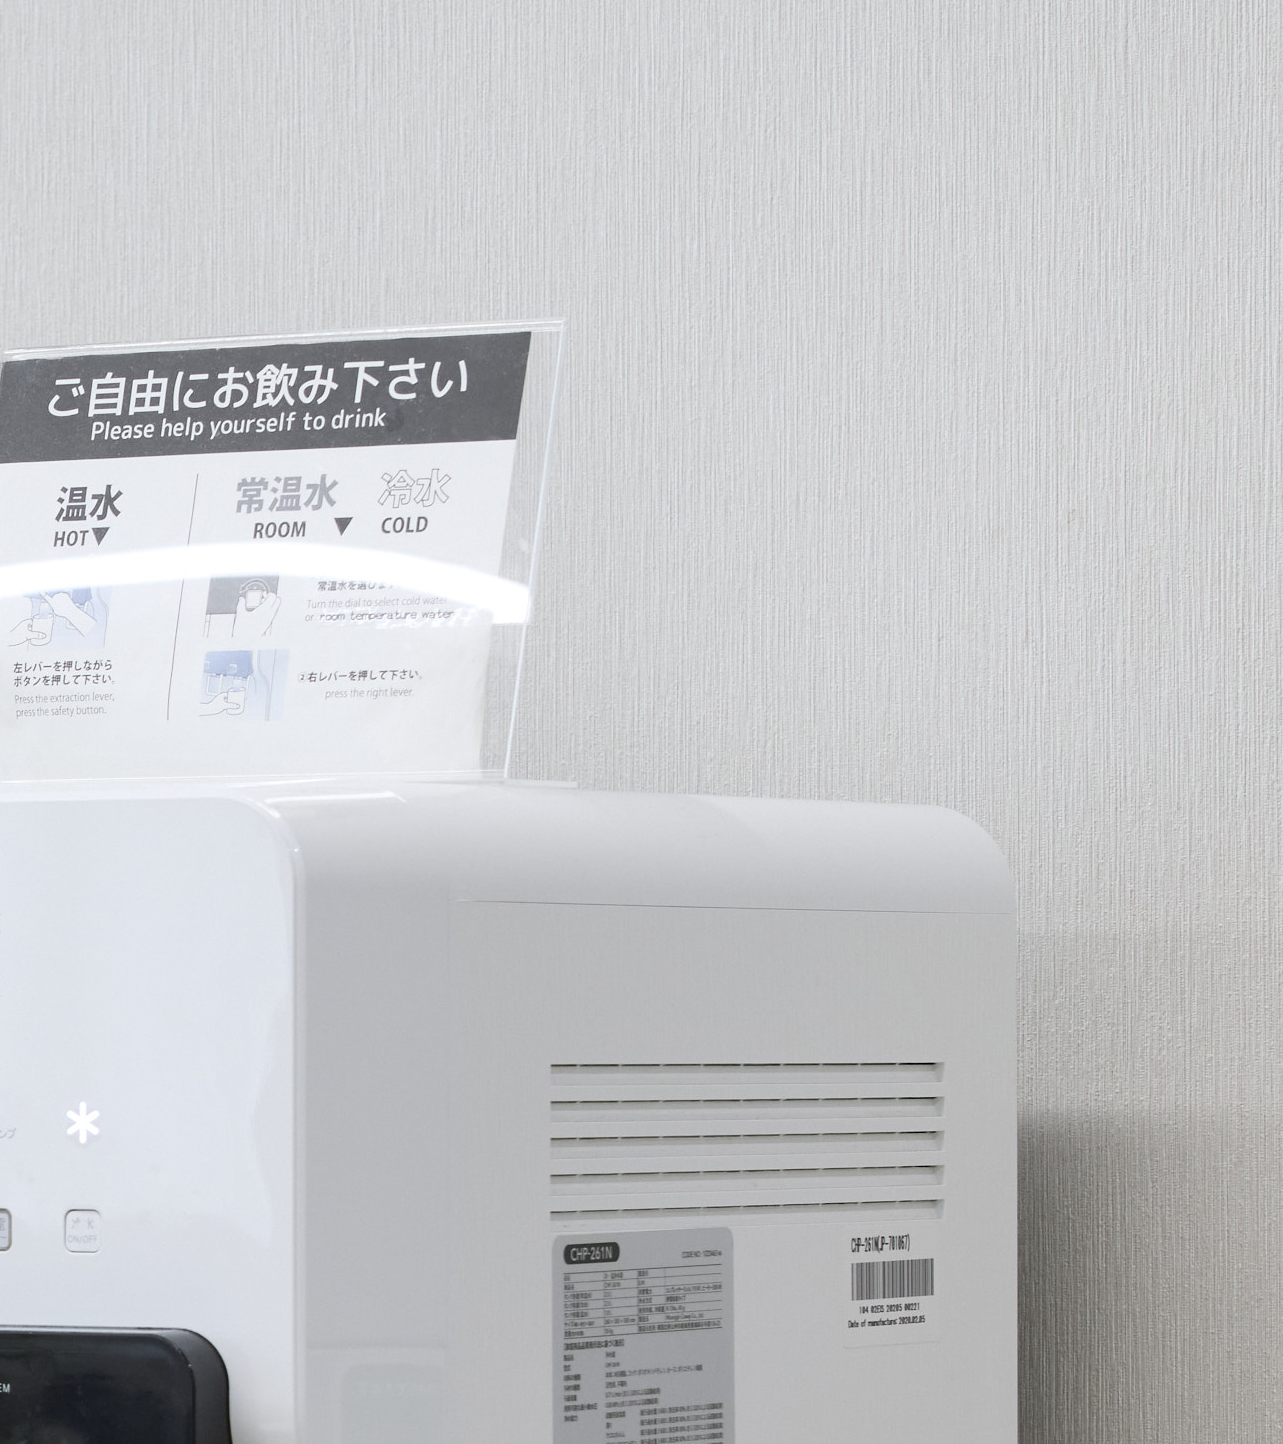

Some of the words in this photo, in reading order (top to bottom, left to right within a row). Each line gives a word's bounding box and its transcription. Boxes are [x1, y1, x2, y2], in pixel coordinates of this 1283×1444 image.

[46, 356, 468, 418] ご自由にお飲み下さい
[90, 421, 154, 441] Please
[160, 416, 203, 439] help
[209, 411, 296, 440] yourself
[303, 413, 325, 431] to
[331, 407, 386, 429] drink
[235, 473, 339, 515] 常温水
[377, 468, 452, 509] 冷水
[54, 484, 124, 523] 温水
[253, 521, 307, 539] ROOM
[381, 516, 429, 534] COLD
[53, 530, 89, 548] HOT
[307, 600, 326, 609] Turn
[328, 599, 343, 608] the
[345, 598, 361, 608] dial
[363, 599, 373, 607] to
[374, 597, 399, 607] select
[401, 596, 421, 606] cold
[305, 614, 315, 622] or
[319, 613, 346, 621] room
[350, 611, 417, 622] temperature
[422, 610, 455, 619] water
[14, 660, 113, 674] 左レバーを押しながら
[15, 694, 34, 704] Press
[35, 694, 48, 703] the
[50, 692, 91, 703] extraction
[325, 690, 348, 701] press
[350, 688, 365, 698] the
[366, 687, 388, 700] right
[16, 708, 35, 719] press
[37, 707, 49, 716] the
[51, 706, 74, 717] safety
[67, 1233, 99, 1244] ON/OFF
[570, 1245, 613, 1261] CHP-261N
